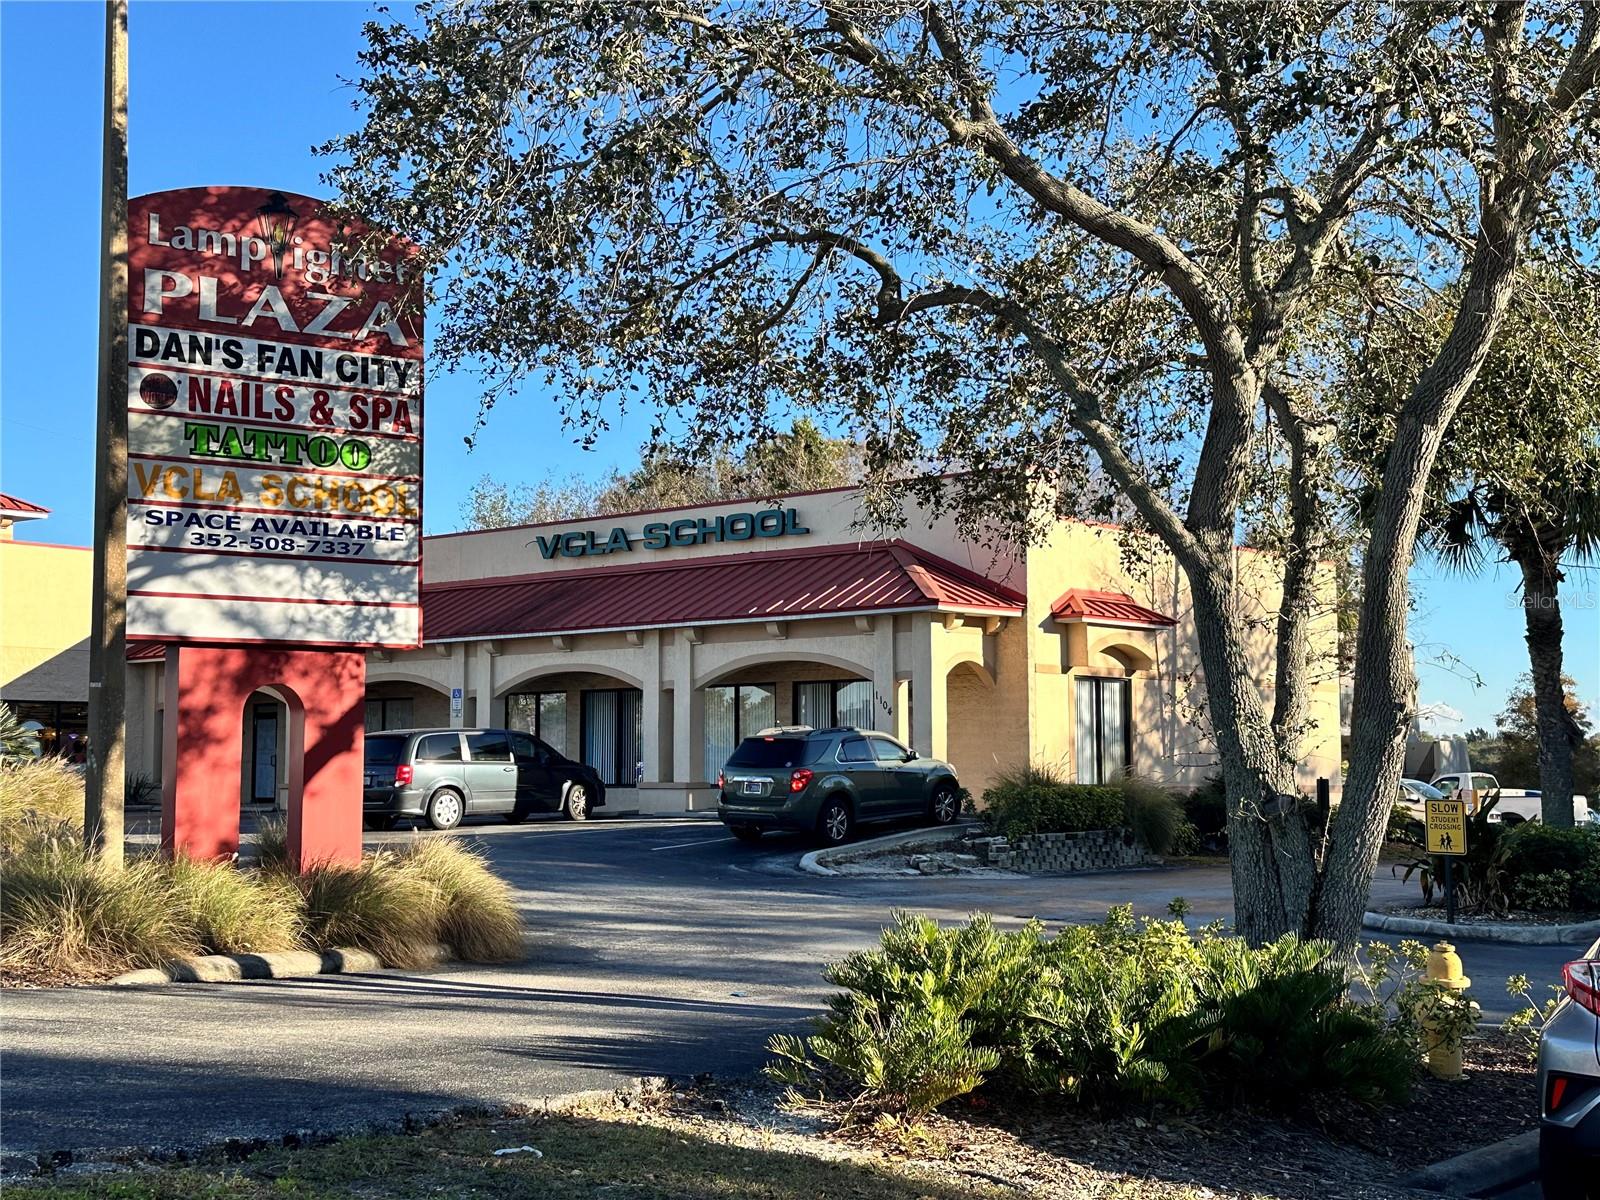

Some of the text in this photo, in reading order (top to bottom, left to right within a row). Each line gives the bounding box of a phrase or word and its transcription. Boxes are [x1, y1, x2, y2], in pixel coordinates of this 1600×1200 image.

[143, 268, 409, 347] PLAZA
[135, 328, 413, 388] DAN'S FAN CITY
[188, 376, 413, 434] NAILS & SPA
[184, 422, 371, 471] TATTOO
[131, 463, 417, 517] VCLA SCHOOL
[145, 510, 404, 542] SPACE AVAILABLE
[190, 532, 365, 556] 352-508-7337
[536, 508, 810, 560] VCLA SCHOOL
[875, 690, 893, 716] 1104
[1429, 823, 1462, 831] CROSSING
[1431, 803, 1459, 813] SLOW
